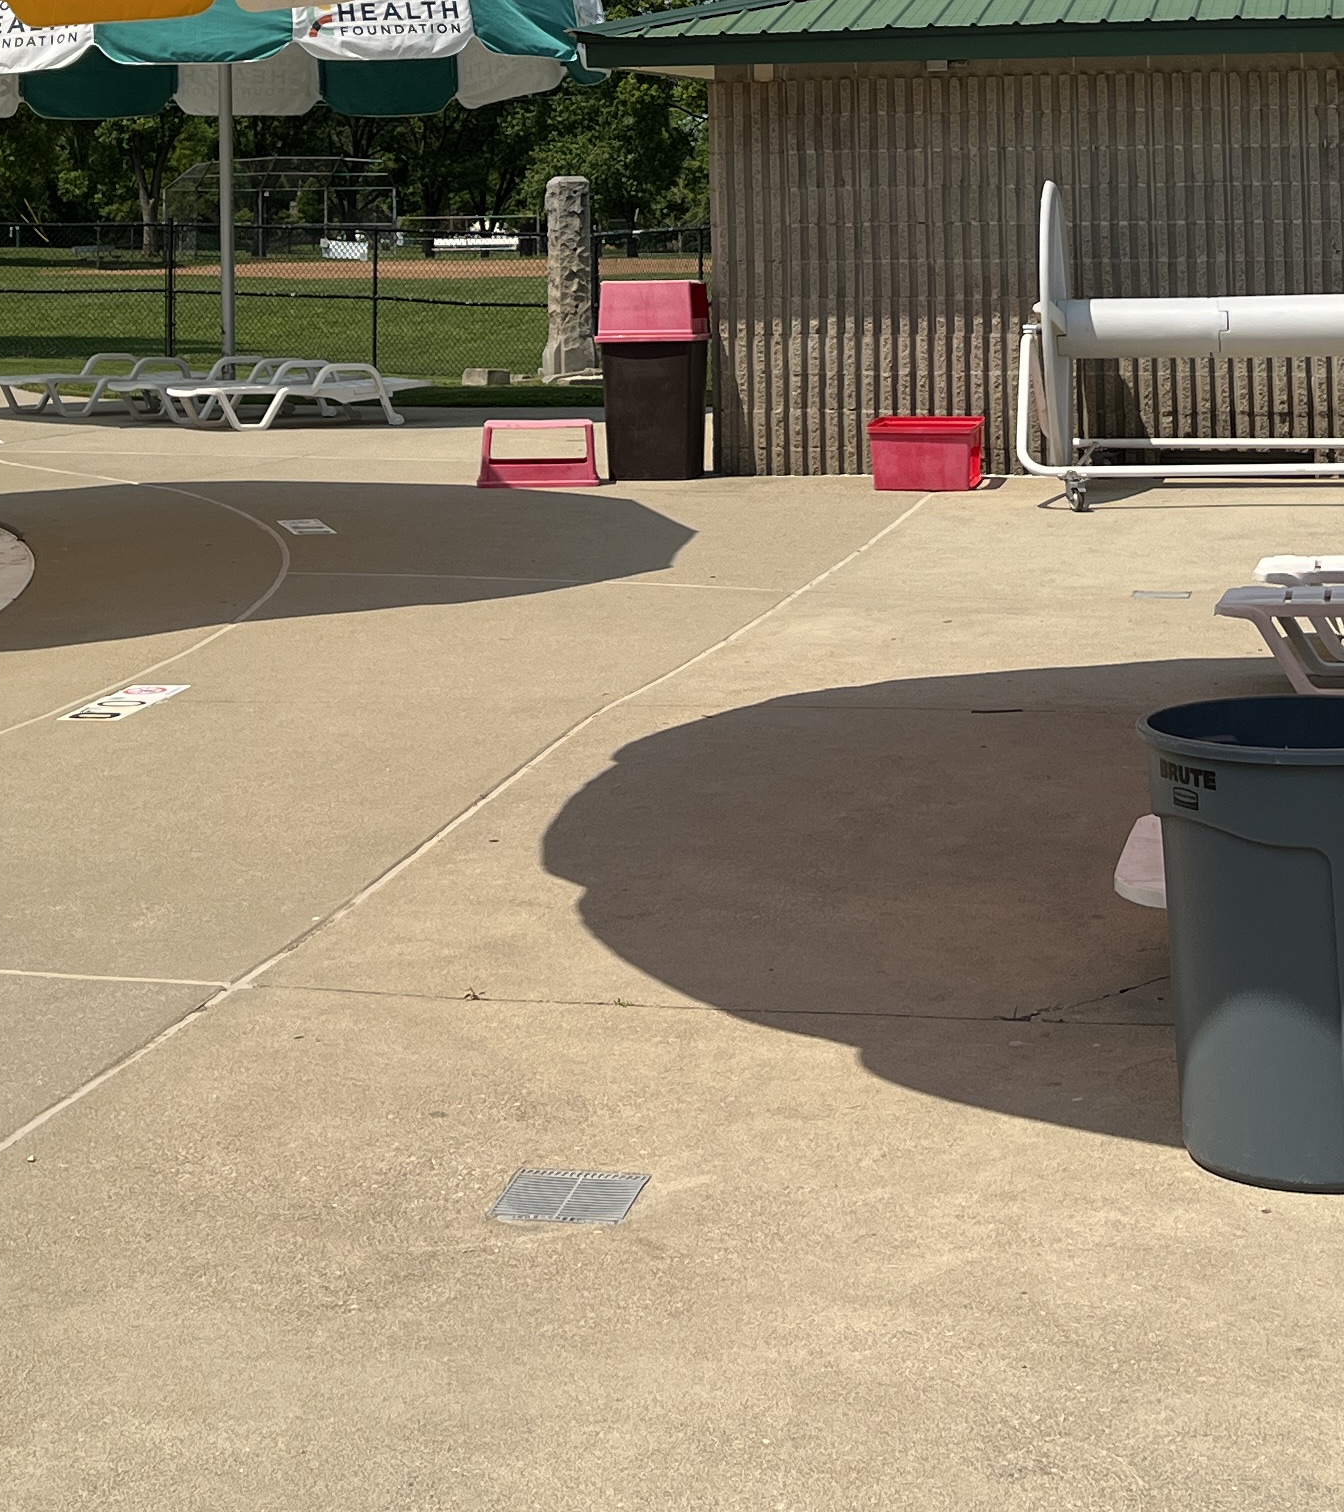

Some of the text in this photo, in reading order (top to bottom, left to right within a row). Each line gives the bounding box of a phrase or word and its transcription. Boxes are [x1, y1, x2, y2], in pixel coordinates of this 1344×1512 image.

[337, 0, 460, 22] HEALTH
[340, 23, 461, 37] FOUNDATION
[1159, 757, 1217, 791] BRUTE
